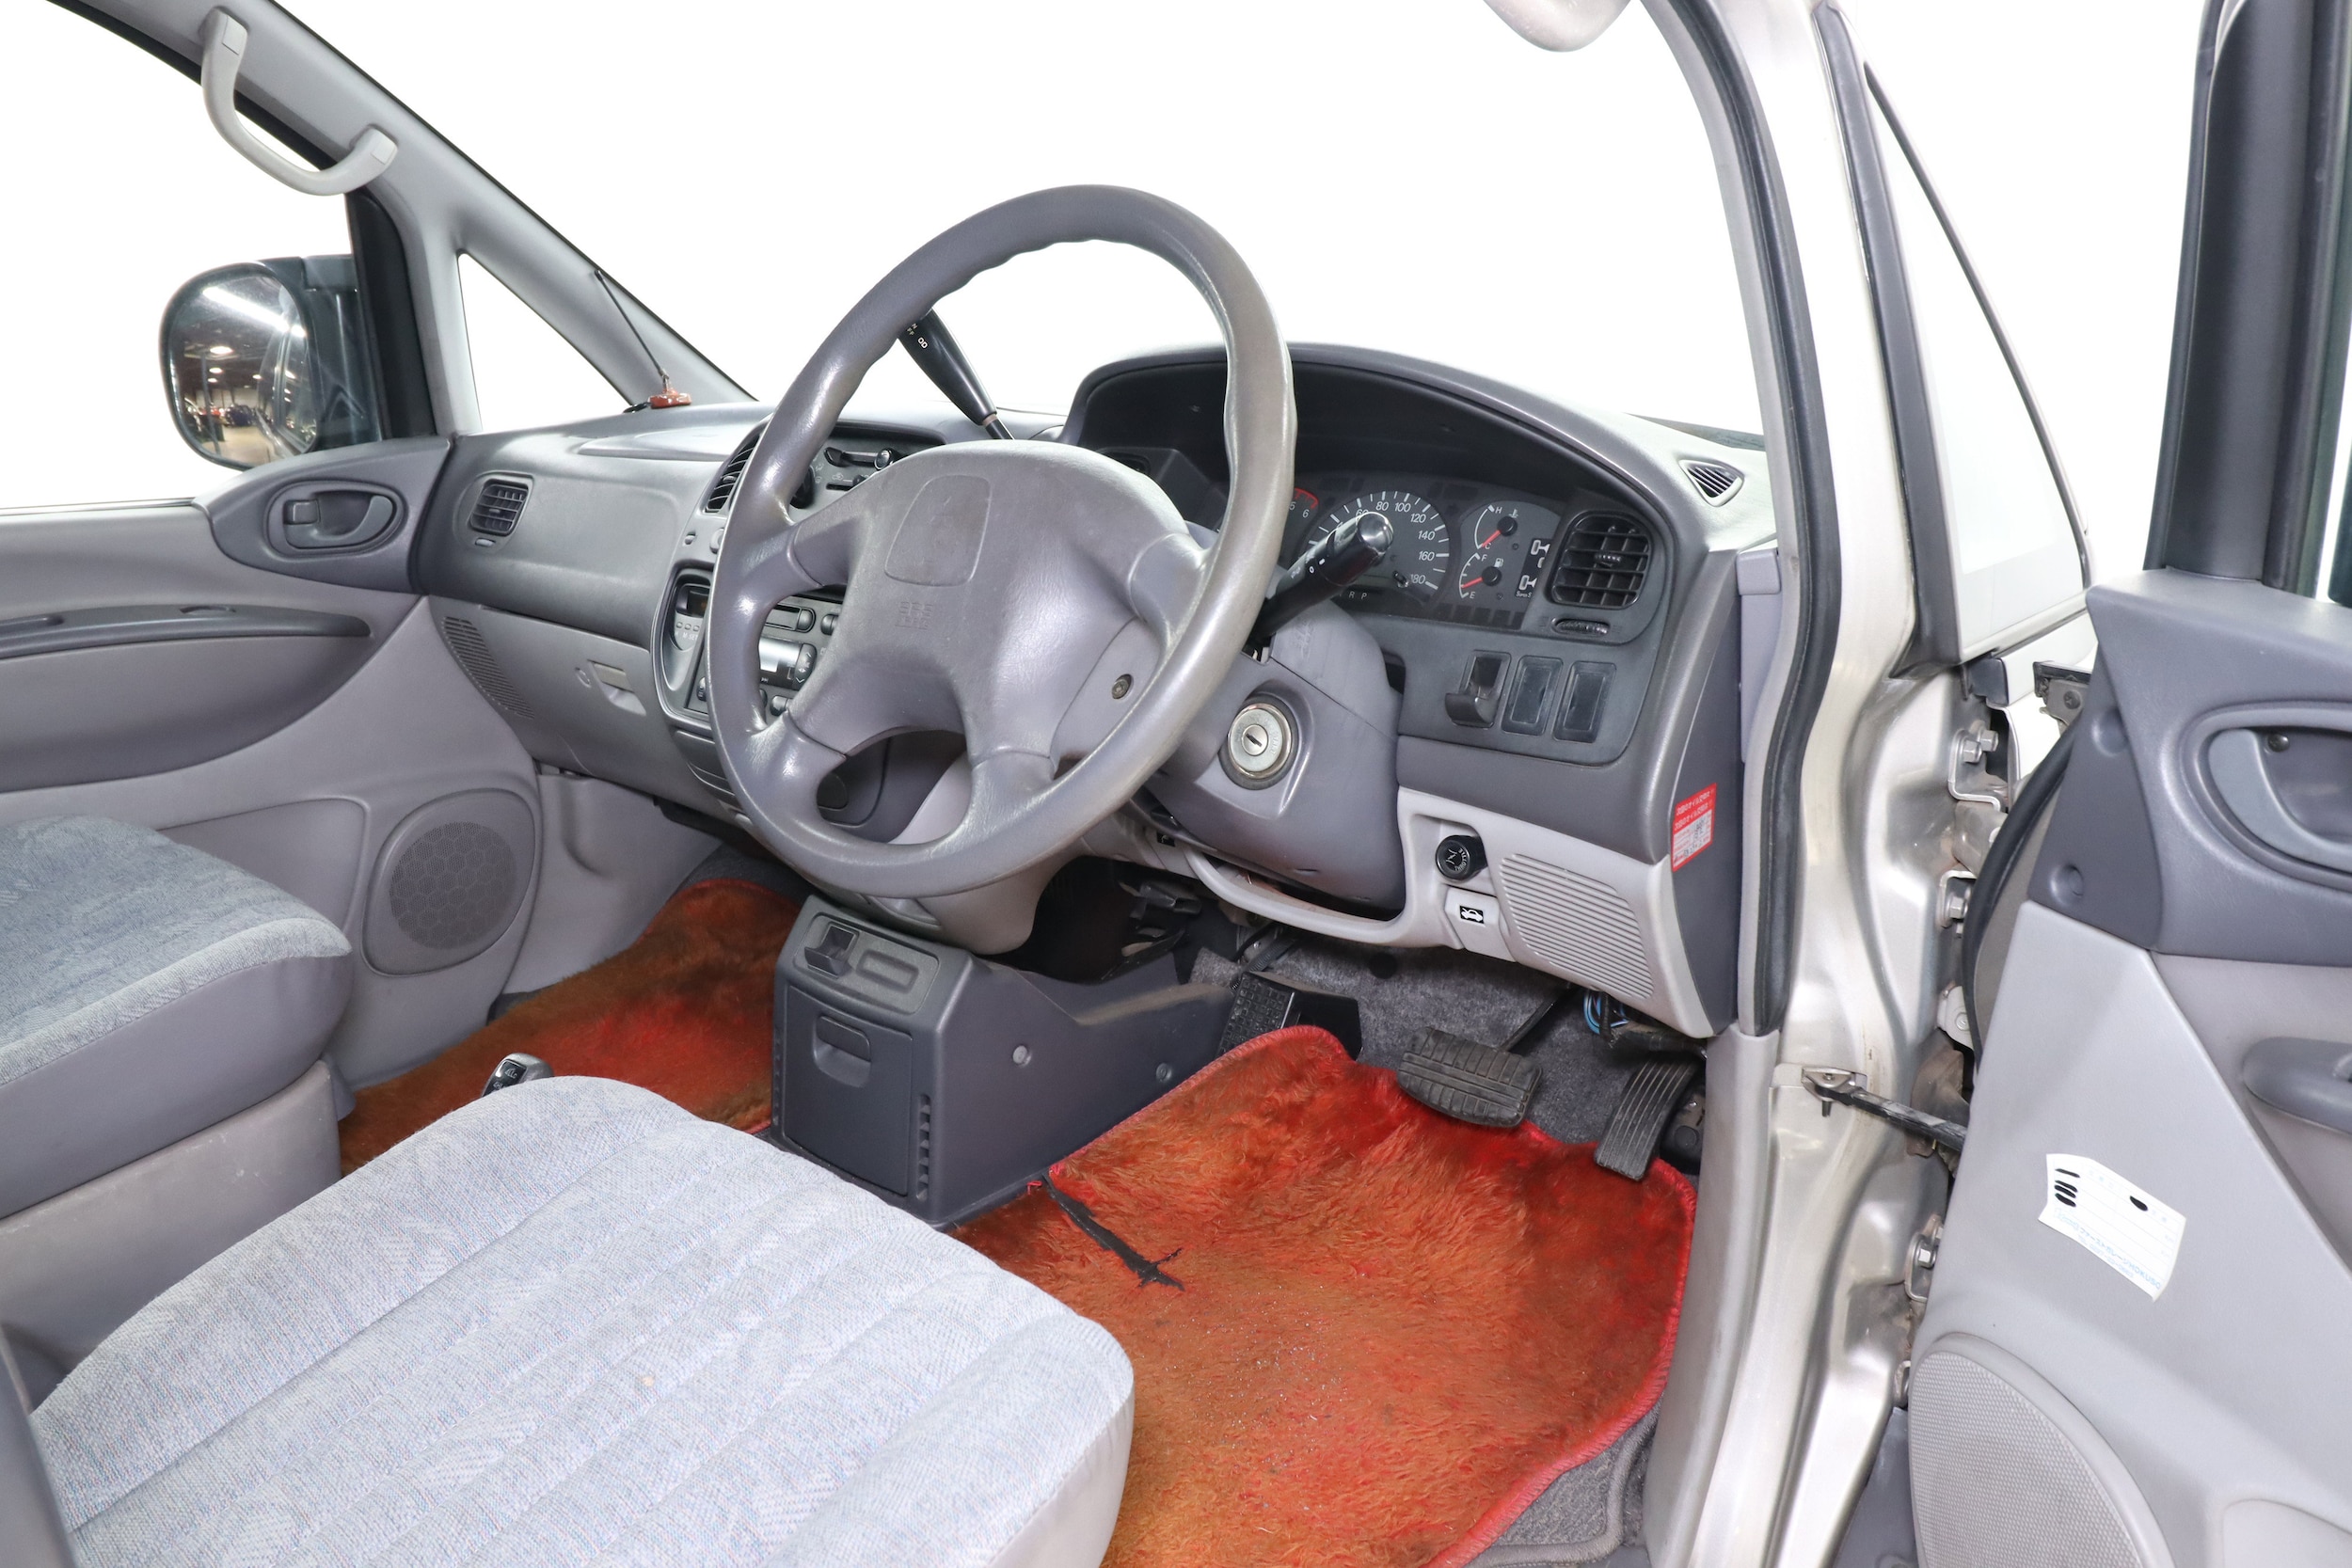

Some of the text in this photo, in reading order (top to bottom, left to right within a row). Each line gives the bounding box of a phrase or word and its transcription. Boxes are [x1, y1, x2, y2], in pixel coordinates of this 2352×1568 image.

[1289, 501, 1296, 511] 5
[1375, 501, 1389, 511] 80
[1394, 502, 1411, 513] 100
[1302, 509, 1310, 518] 6
[1410, 513, 1426, 523] 120
[1418, 530, 1436, 541] 140
[1485, 542, 1492, 550] C
[1418, 550, 1435, 562] 160
[1410, 574, 1426, 584] 180
[1349, 591, 1355, 599] R
